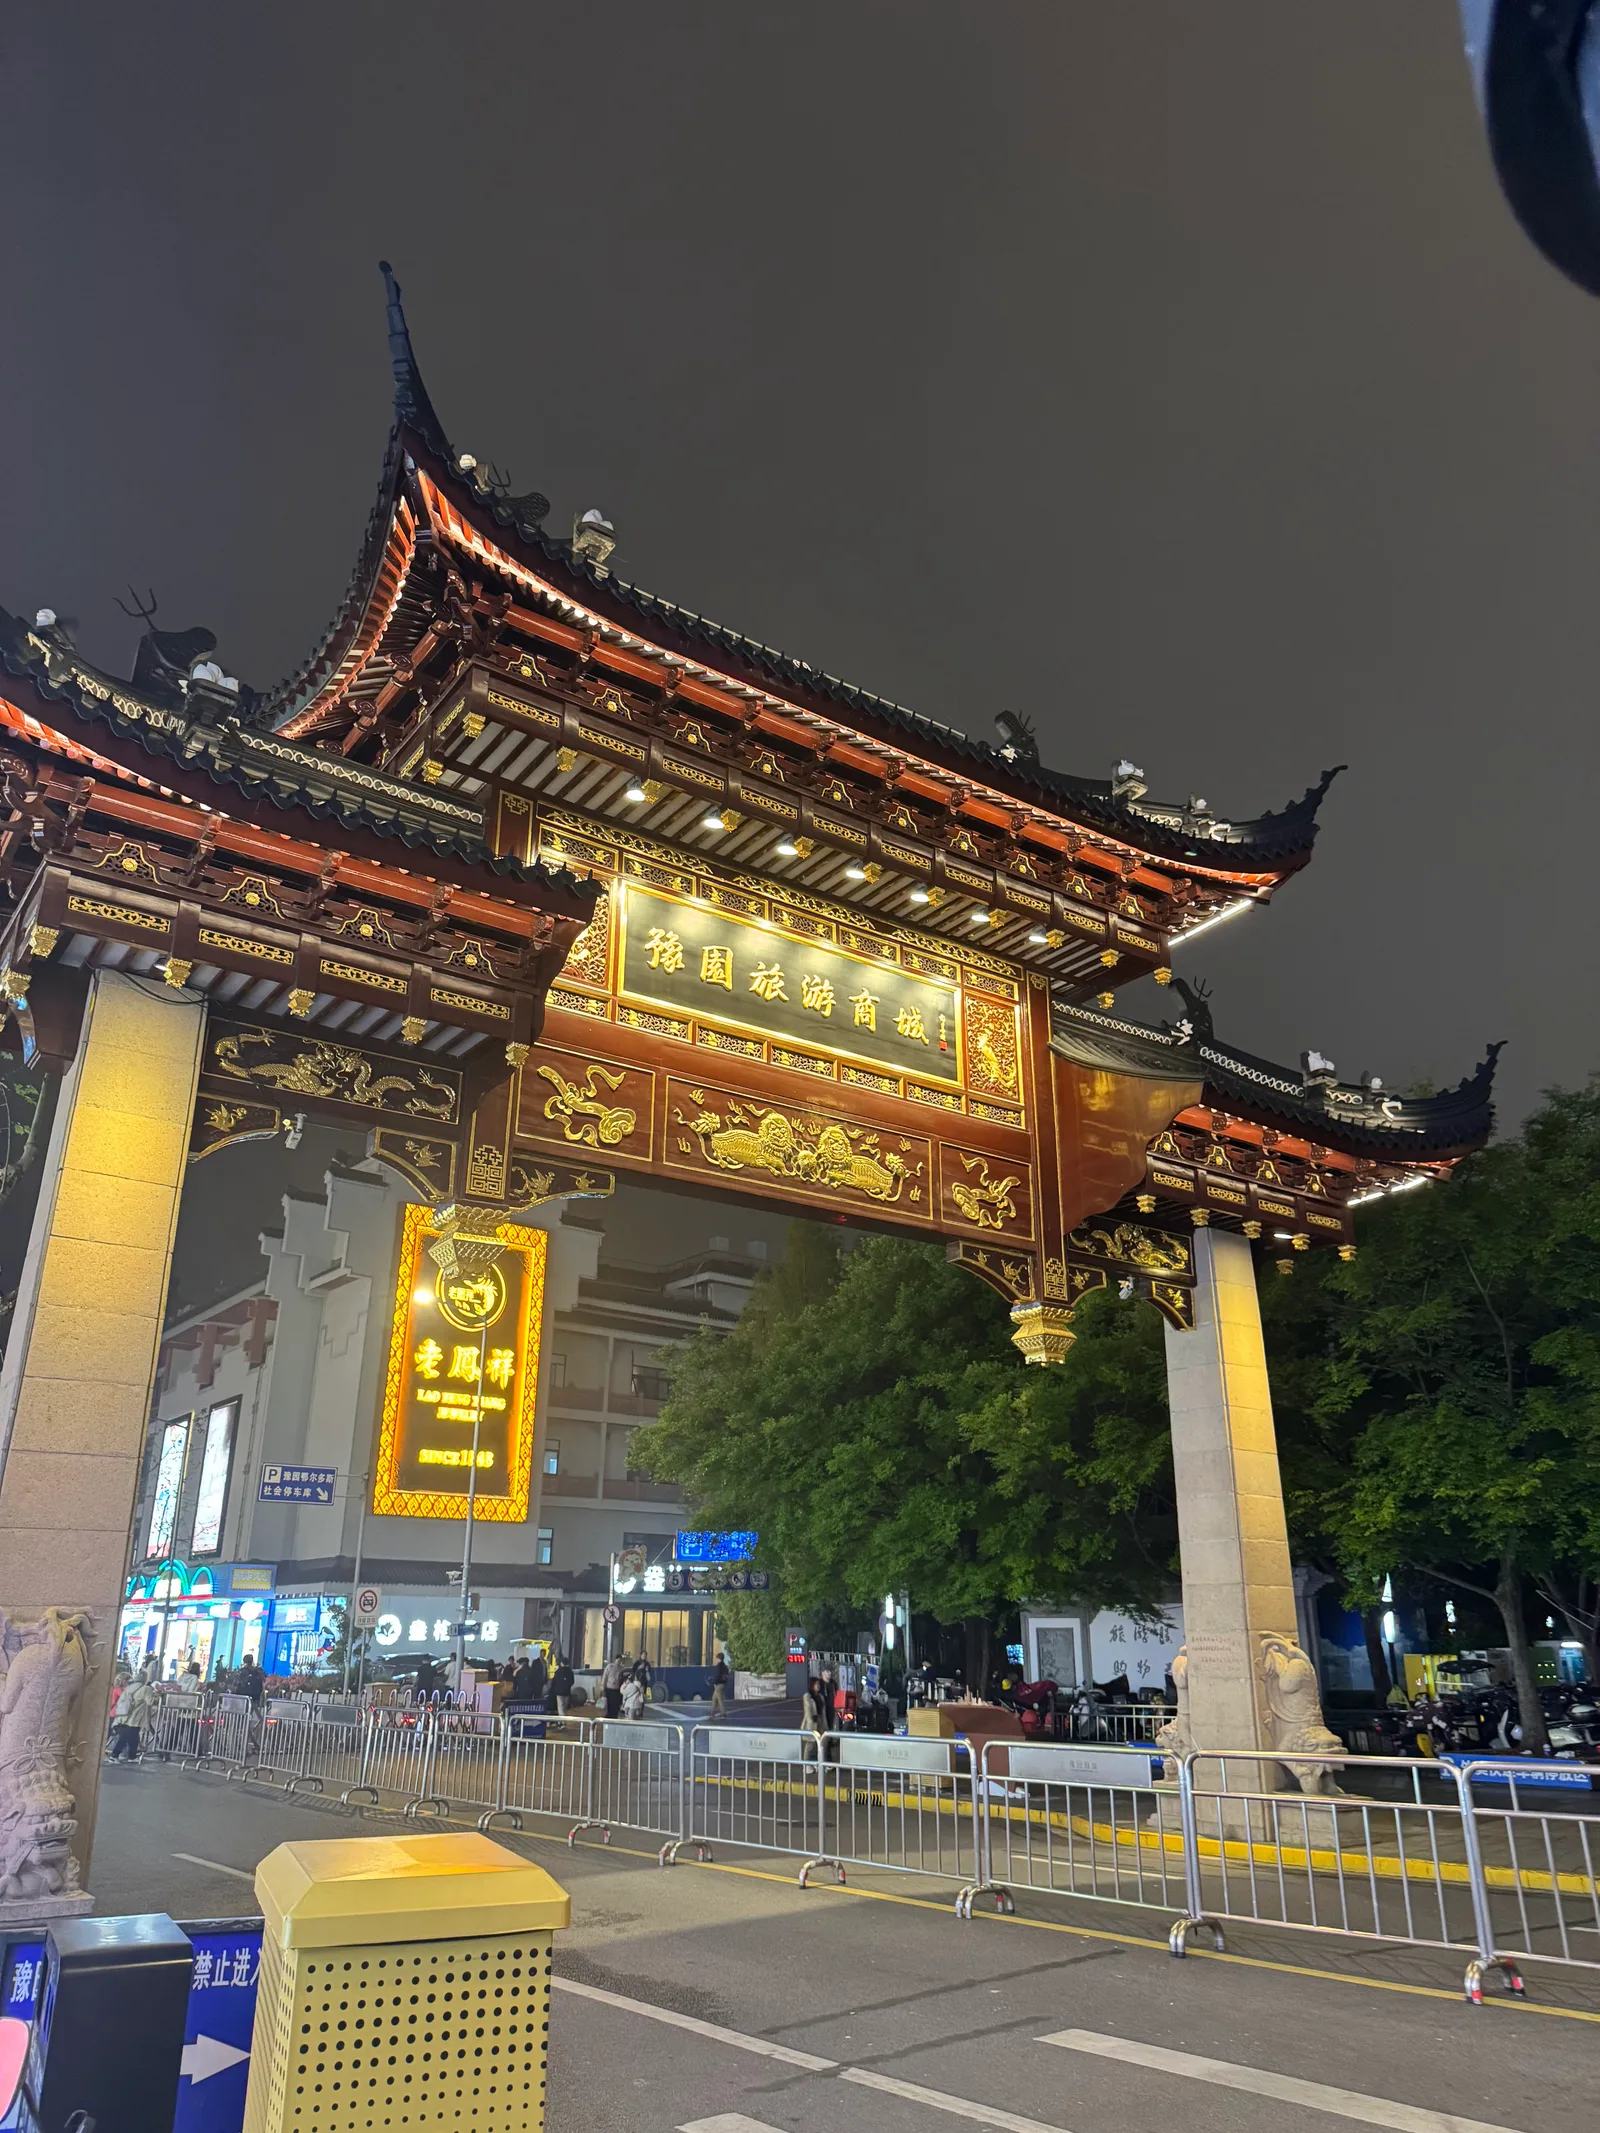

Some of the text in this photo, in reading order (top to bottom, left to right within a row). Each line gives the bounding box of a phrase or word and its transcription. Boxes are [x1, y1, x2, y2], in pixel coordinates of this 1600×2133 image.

[264, 1485, 311, 1498] 社会停车库
